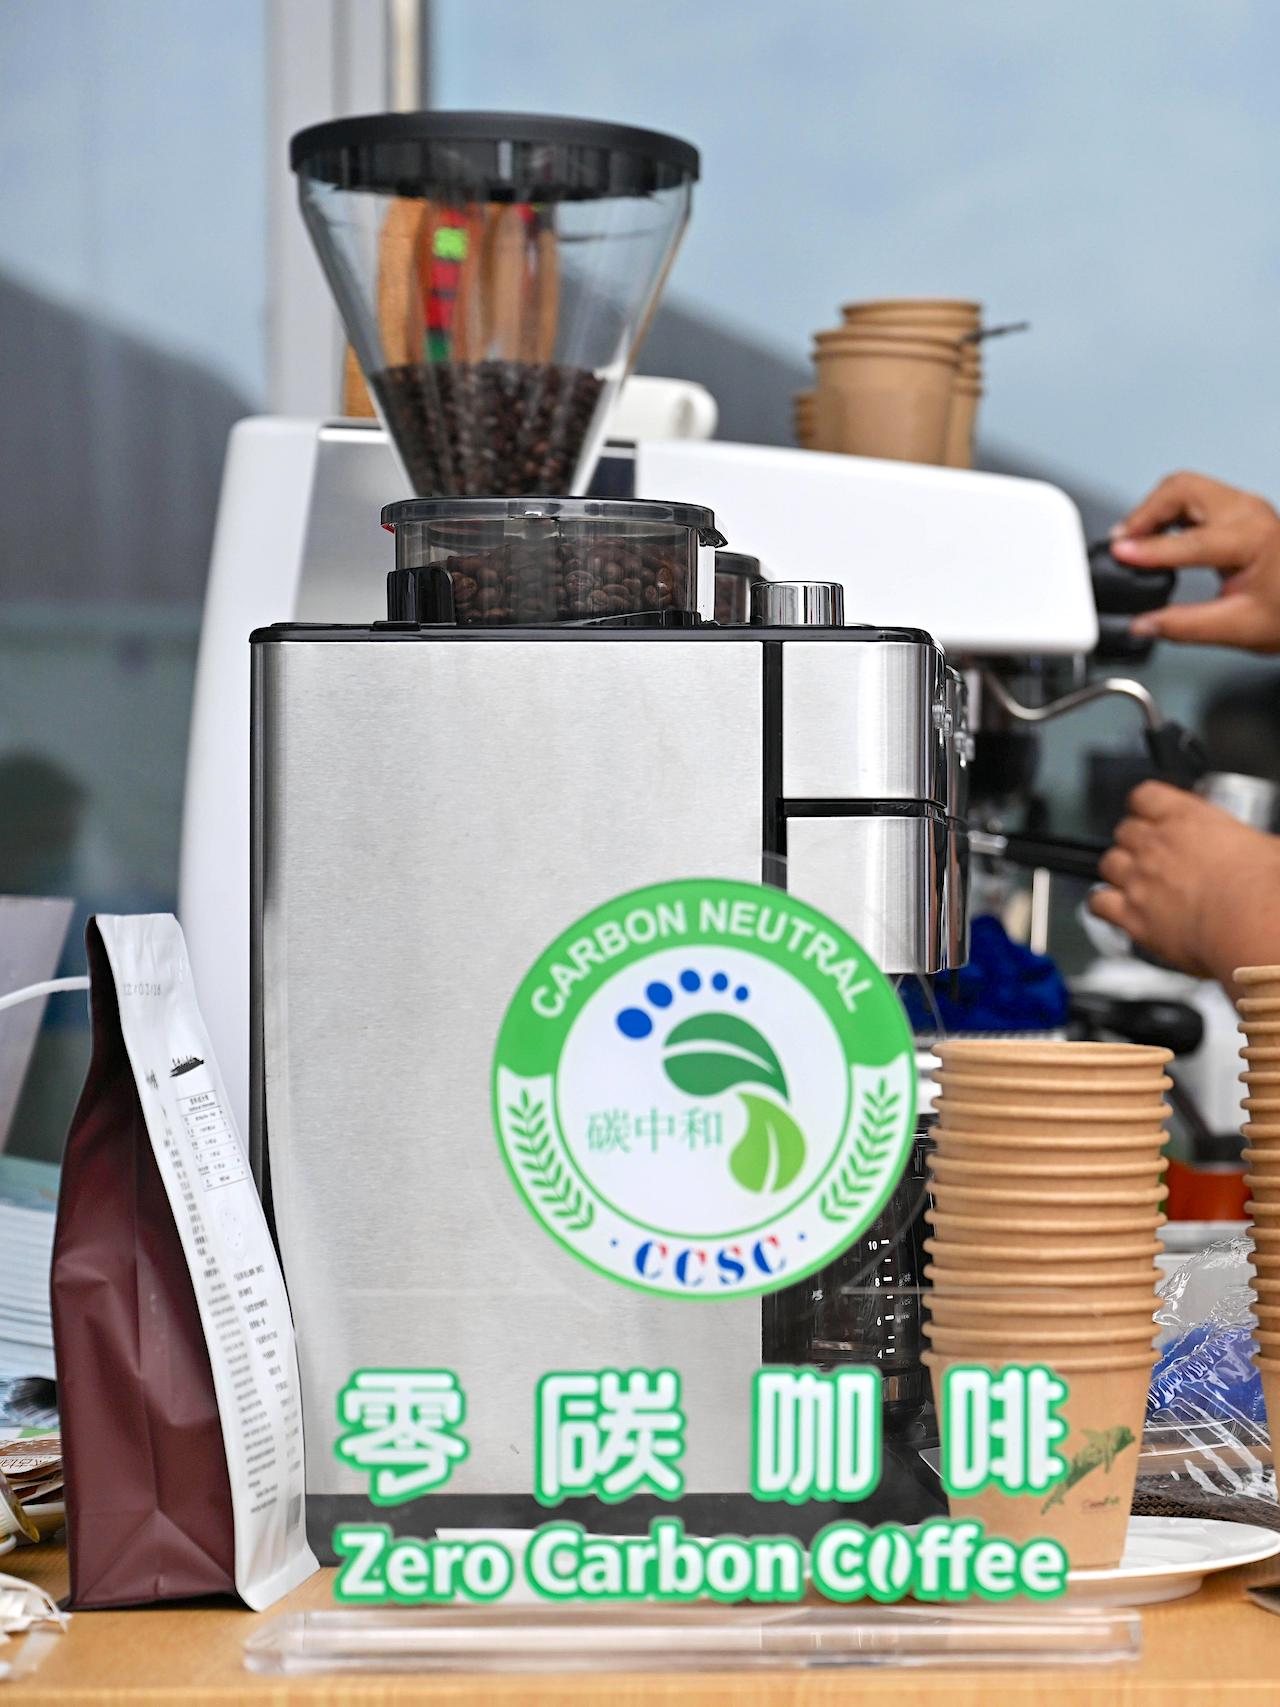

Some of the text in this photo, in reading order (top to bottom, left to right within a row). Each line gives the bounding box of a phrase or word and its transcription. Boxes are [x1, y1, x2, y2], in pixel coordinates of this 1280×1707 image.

[531, 898, 873, 1018] CARBON NEUTRAL
[586, 1106, 723, 1153] 碳中和
[634, 1235, 786, 1287] CCSC
[868, 1240, 878, 1251] 10
[874, 1277, 881, 1288] 8
[876, 1316, 882, 1327] 6
[877, 1349, 883, 1360] 4
[337, 1370, 1066, 1502] 零碳咖啡
[338, 1519, 1067, 1600] Zero Carbon Coffee
